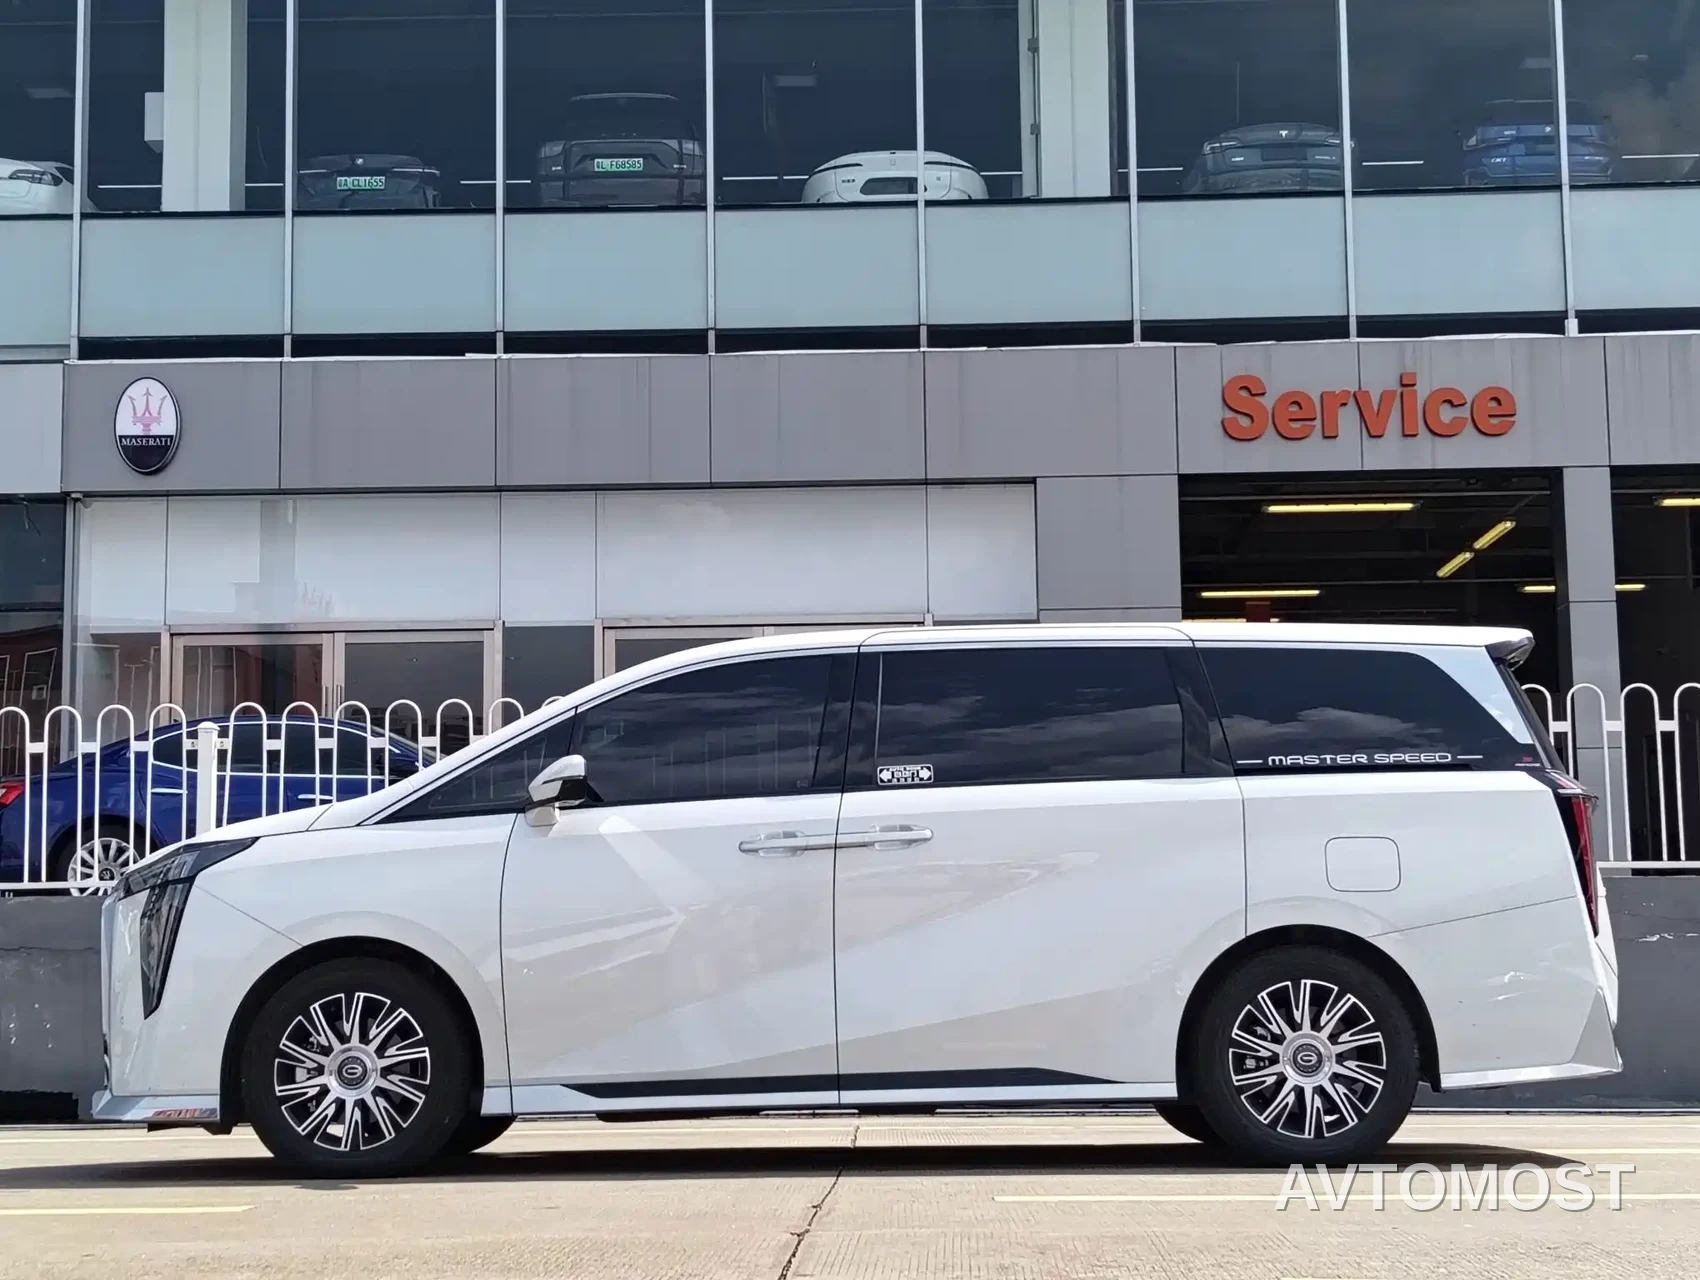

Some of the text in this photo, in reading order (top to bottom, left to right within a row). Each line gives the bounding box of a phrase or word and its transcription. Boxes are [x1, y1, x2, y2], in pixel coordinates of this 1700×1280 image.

[1222, 371, 1517, 440] Service
[121, 437, 171, 446] MASERATI
[1268, 753, 1452, 766] MASTER SPEED
